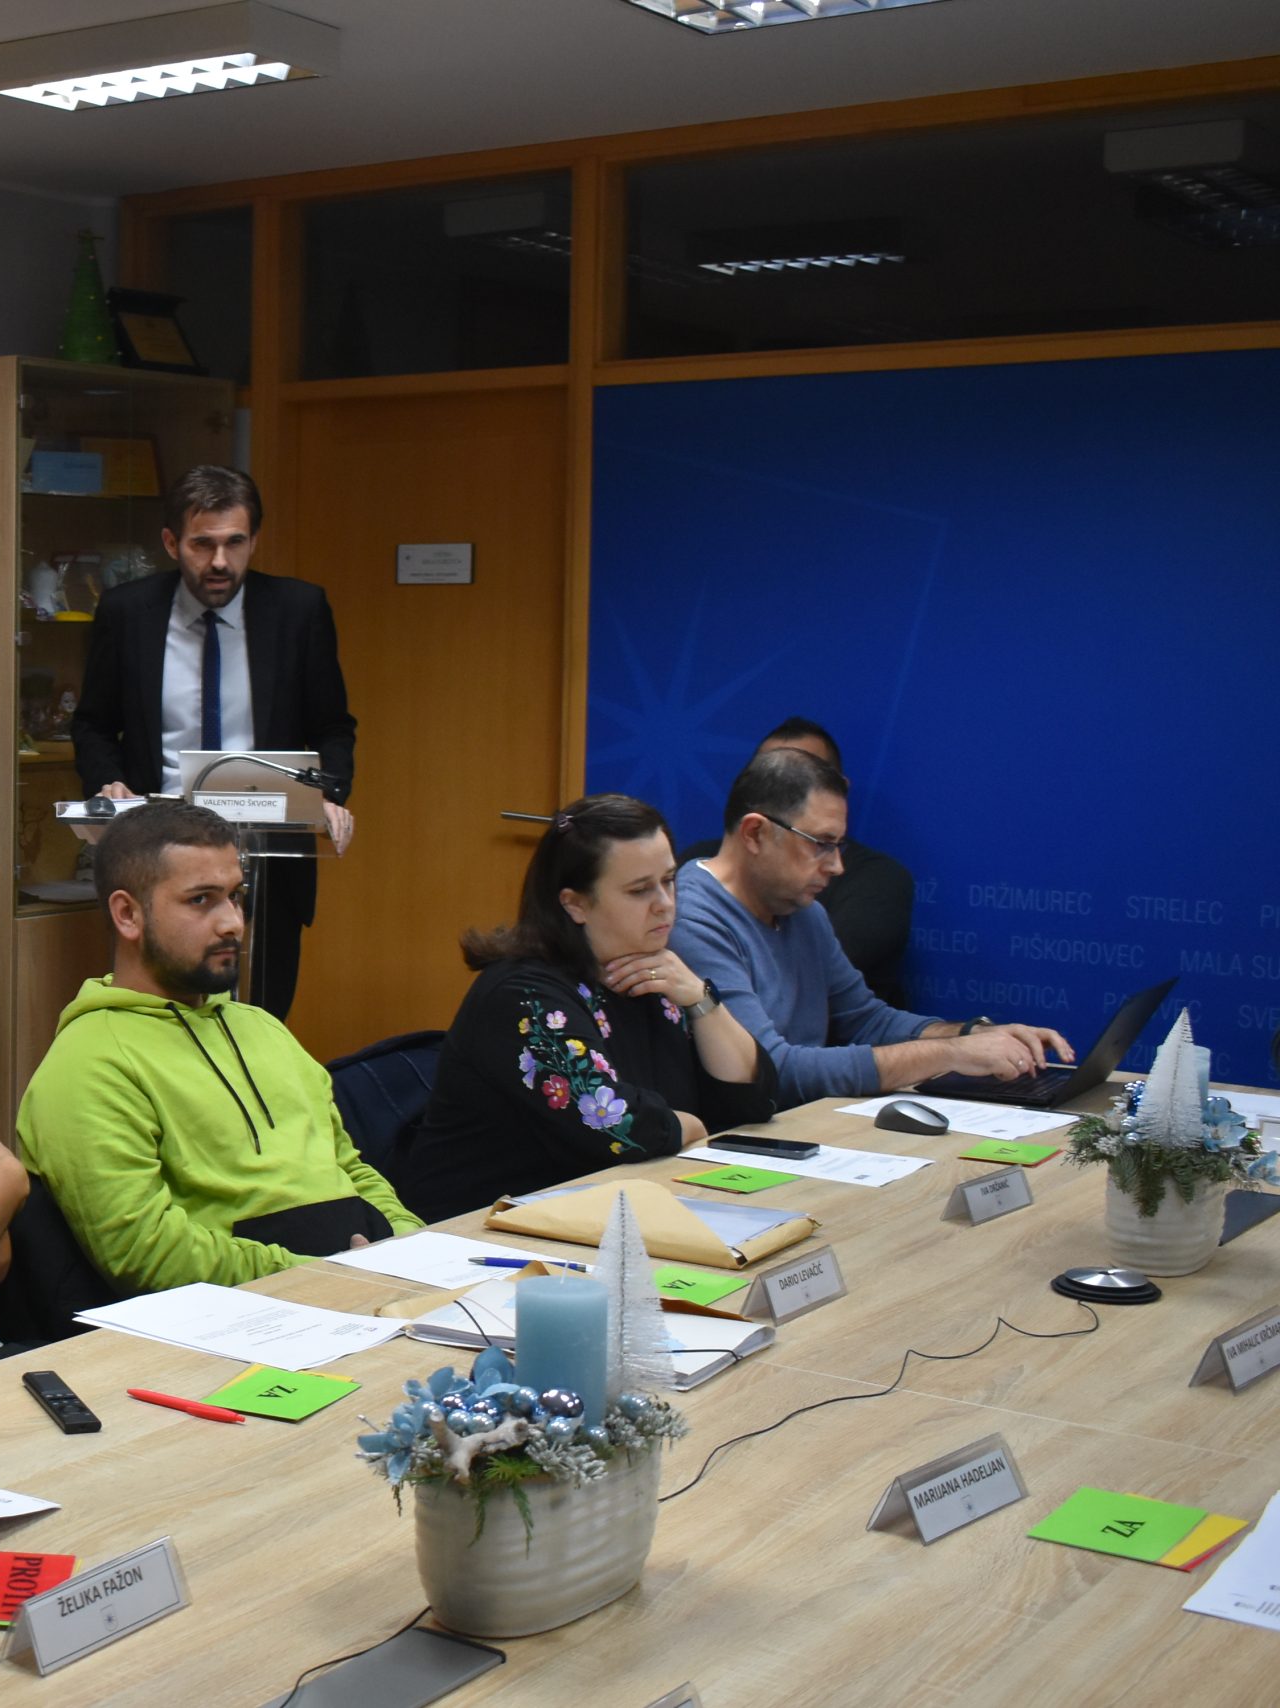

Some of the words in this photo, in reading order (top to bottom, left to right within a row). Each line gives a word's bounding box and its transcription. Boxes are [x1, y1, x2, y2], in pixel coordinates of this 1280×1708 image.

[202, 799, 246, 807] VALENTINO
[969, 882, 1092, 916] DRŽIMUREC
[1126, 895, 1224, 925] STRELEC
[1010, 933, 1145, 969] PIŠKOROVEC
[1179, 950, 1243, 976] MALA
[966, 979, 1070, 1010] SUBOTICA
[778, 1274, 799, 1290] DARIO
[256, 1384, 298, 1398] ZA
[913, 1478, 961, 1509] MARIJANA
[959, 1456, 1006, 1488] HADELJAN
[1100, 1519, 1146, 1538] ZA
[57, 1585, 103, 1618] ŽELJKA
[102, 1565, 144, 1597] FAŽON
